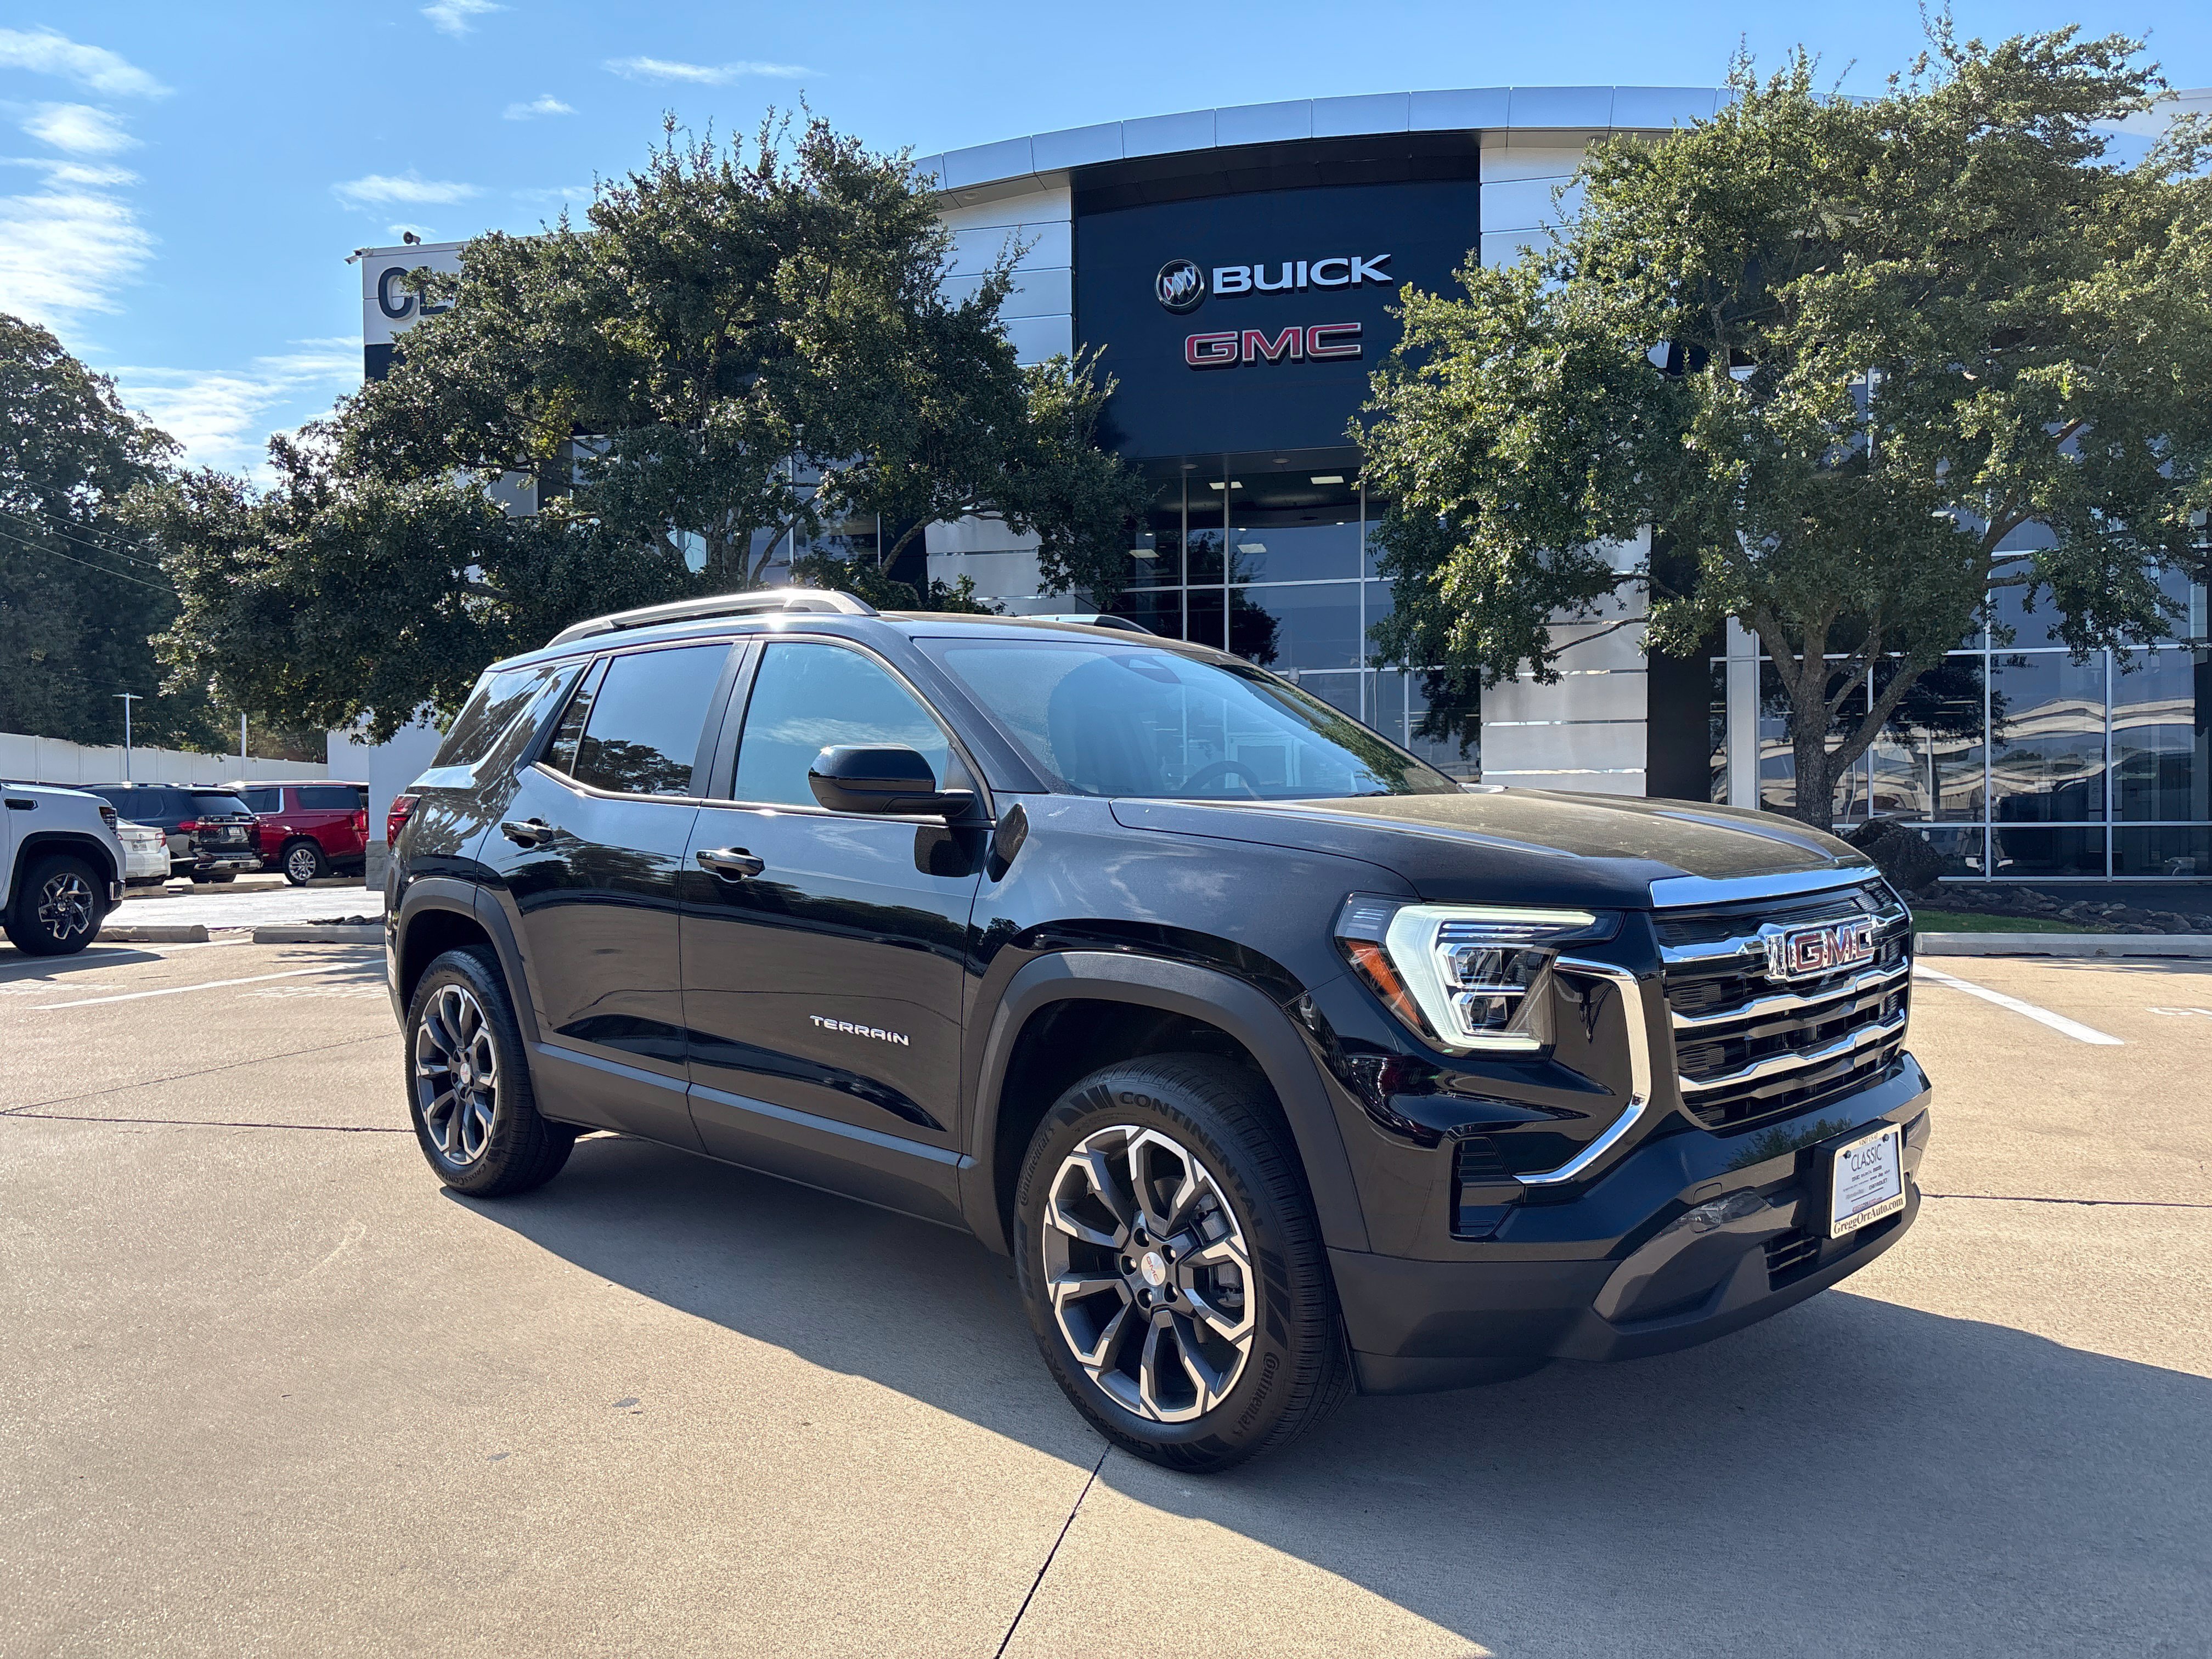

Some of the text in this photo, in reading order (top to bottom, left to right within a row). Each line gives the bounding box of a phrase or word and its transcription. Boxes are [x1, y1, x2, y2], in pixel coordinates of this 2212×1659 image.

[1212, 253, 1393, 294] BUICK
[1185, 322, 1362, 366] GMC
[1790, 923, 1875, 973] GMC
[809, 1015, 910, 1046] TERRAIN
[1118, 1091, 1263, 1238] CONTINENTAL
[1851, 1144, 1882, 1172] CLASSIC
[1834, 1198, 1903, 1234] GreggOrrAuto.com
[1147, 1256, 1160, 1282] GMC
[1237, 1351, 1280, 1431] Continental
